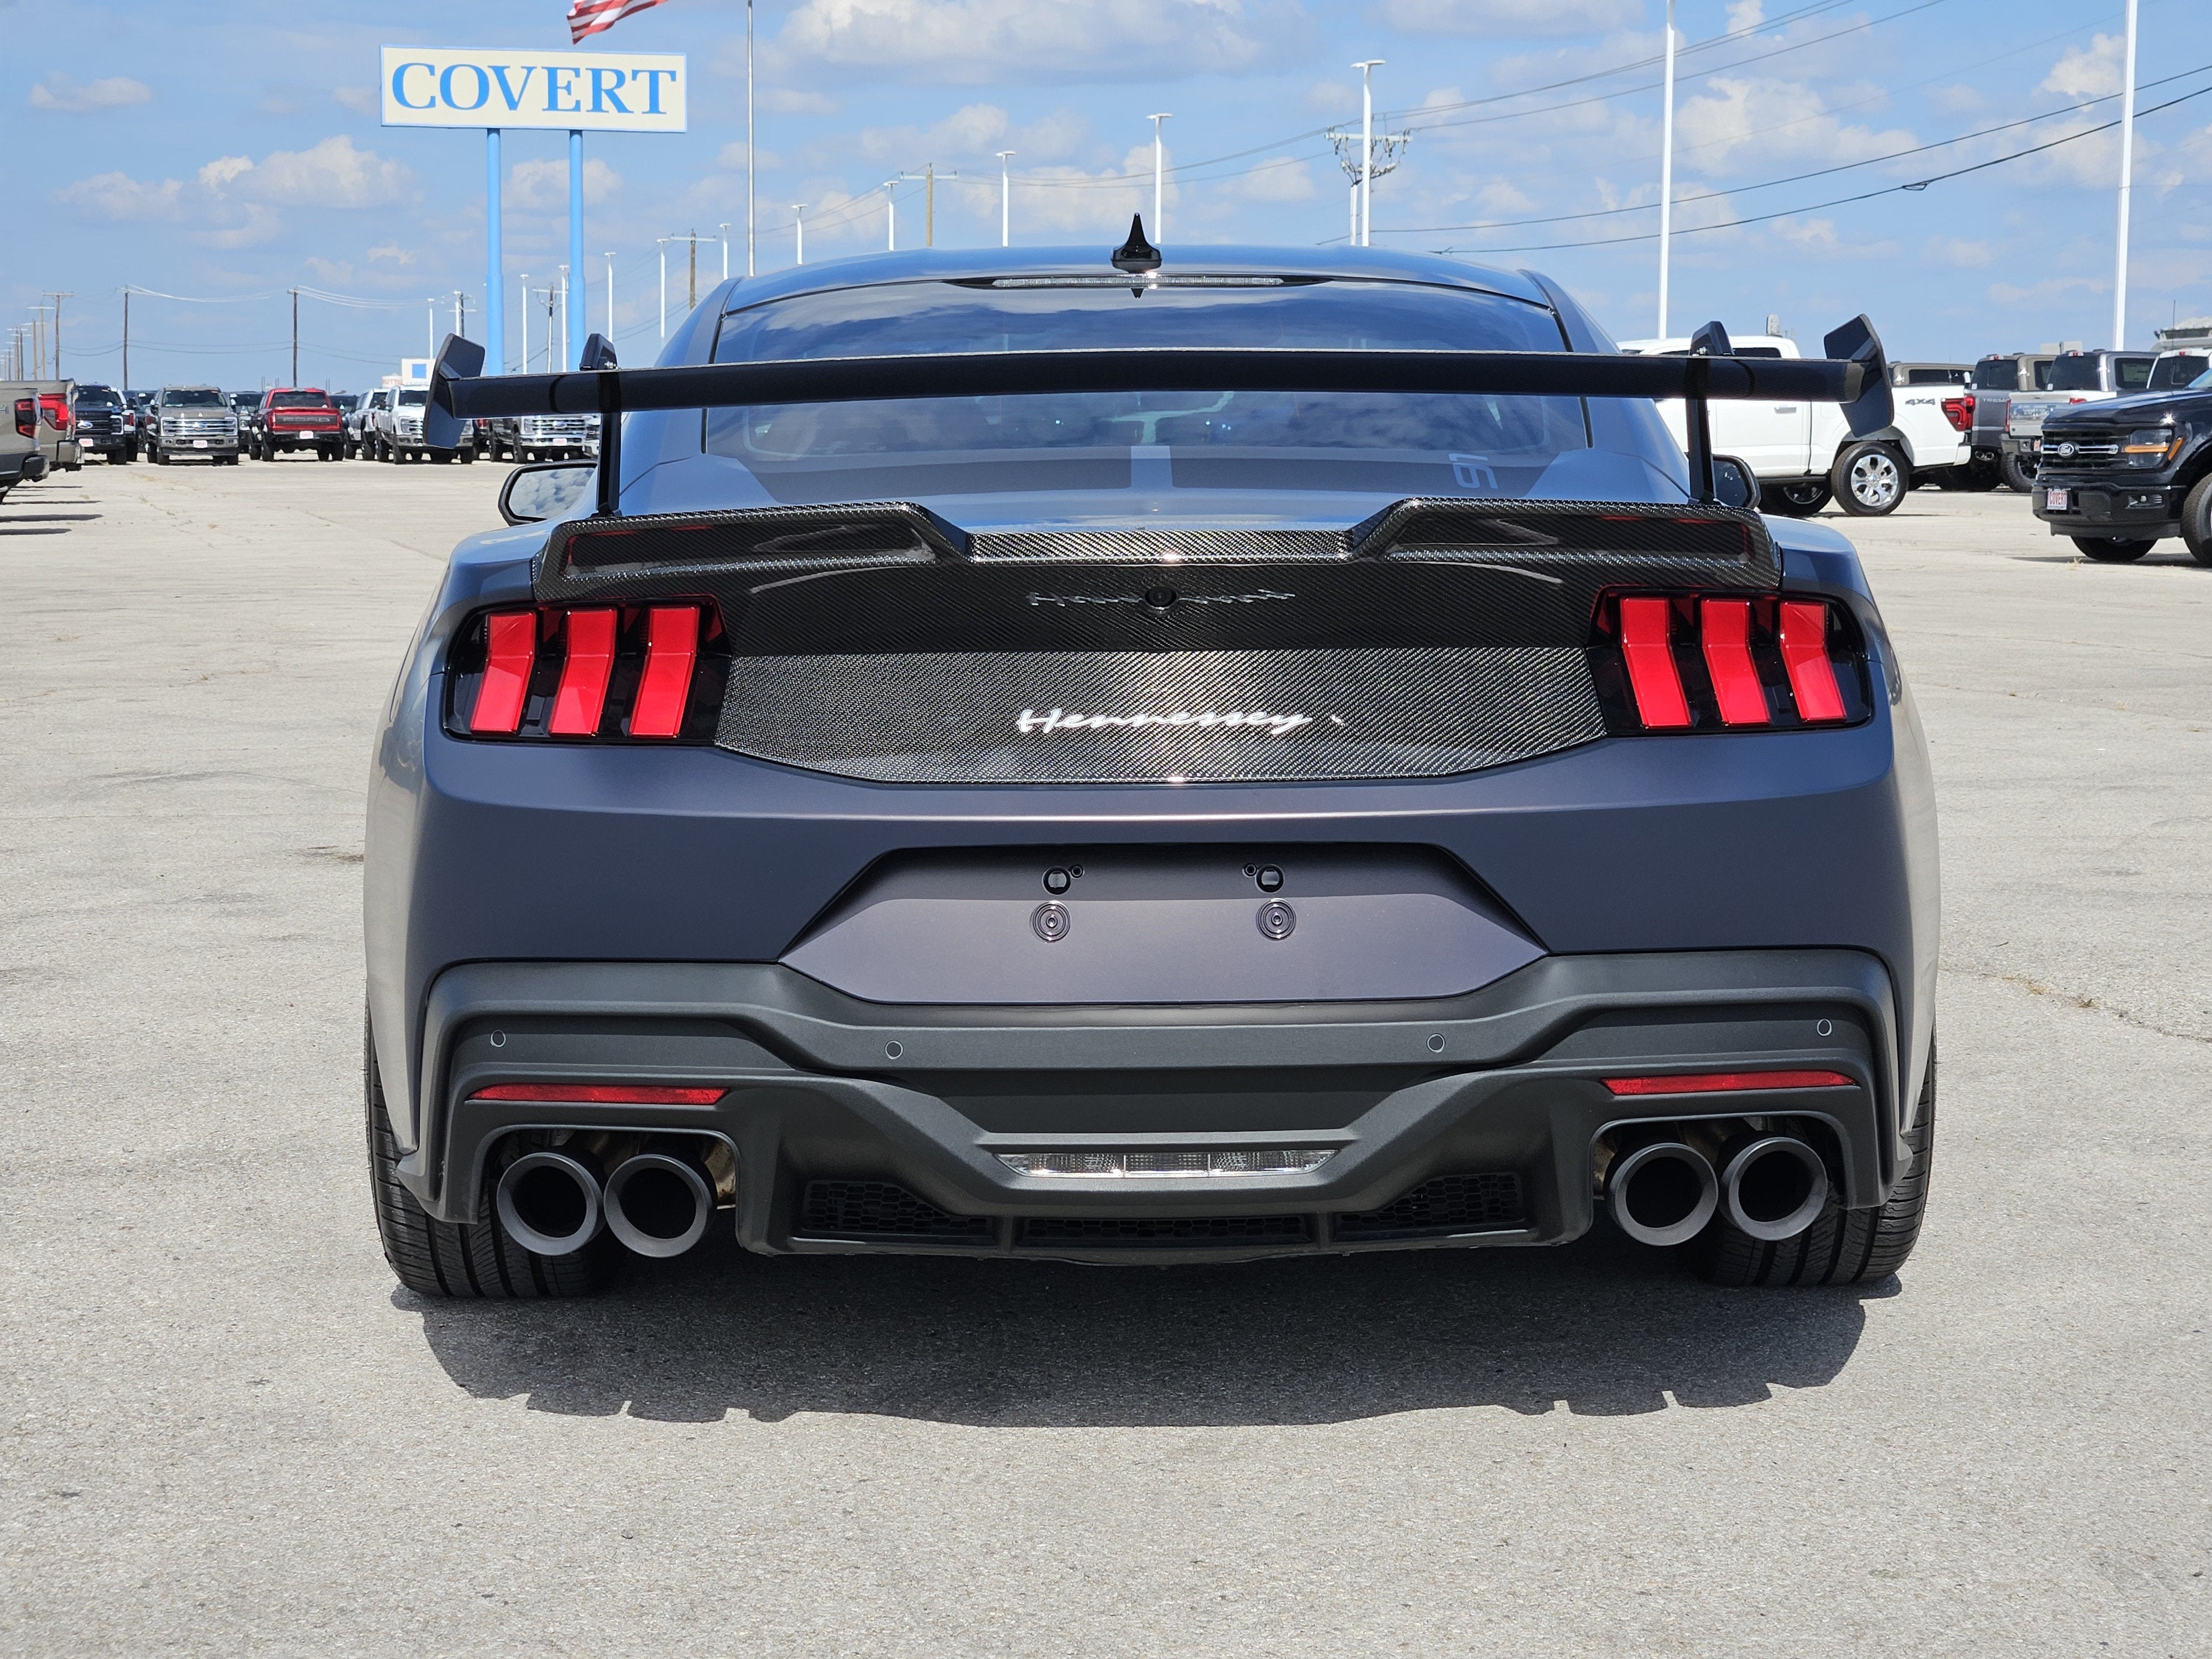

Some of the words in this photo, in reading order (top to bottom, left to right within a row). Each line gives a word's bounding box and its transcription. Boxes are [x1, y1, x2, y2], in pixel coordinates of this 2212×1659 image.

[392, 62, 676, 114] COVERT
[2049, 492, 2066, 505] COVERT
[1018, 708, 1311, 734] Hennessey
